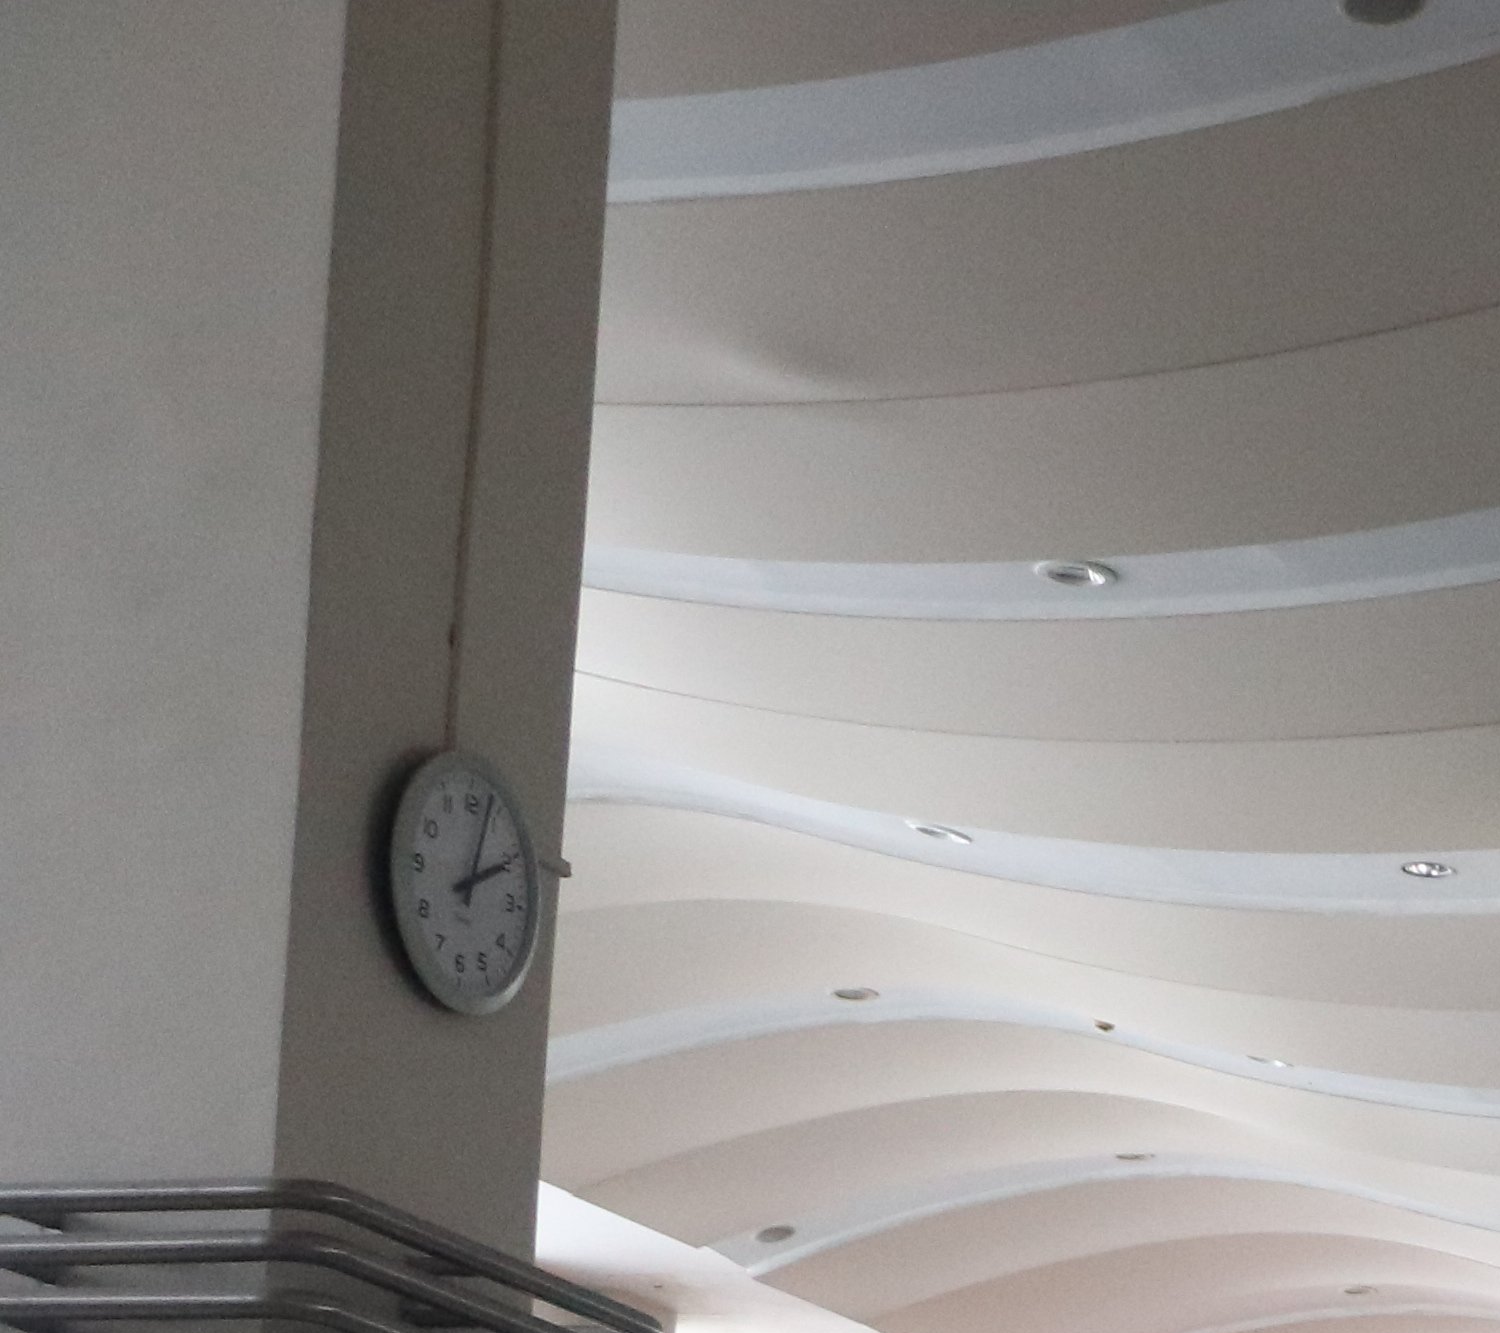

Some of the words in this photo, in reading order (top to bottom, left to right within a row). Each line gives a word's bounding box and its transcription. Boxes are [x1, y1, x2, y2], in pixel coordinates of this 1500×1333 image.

[424, 818, 440, 839] 10
[413, 853, 426, 873] 9
[418, 898, 431, 919] 8
[505, 892, 517, 913] 3
[435, 933, 447, 951] 7
[496, 932, 508, 950] 4
[455, 953, 467, 974] 6
[477, 951, 488, 972] 5
